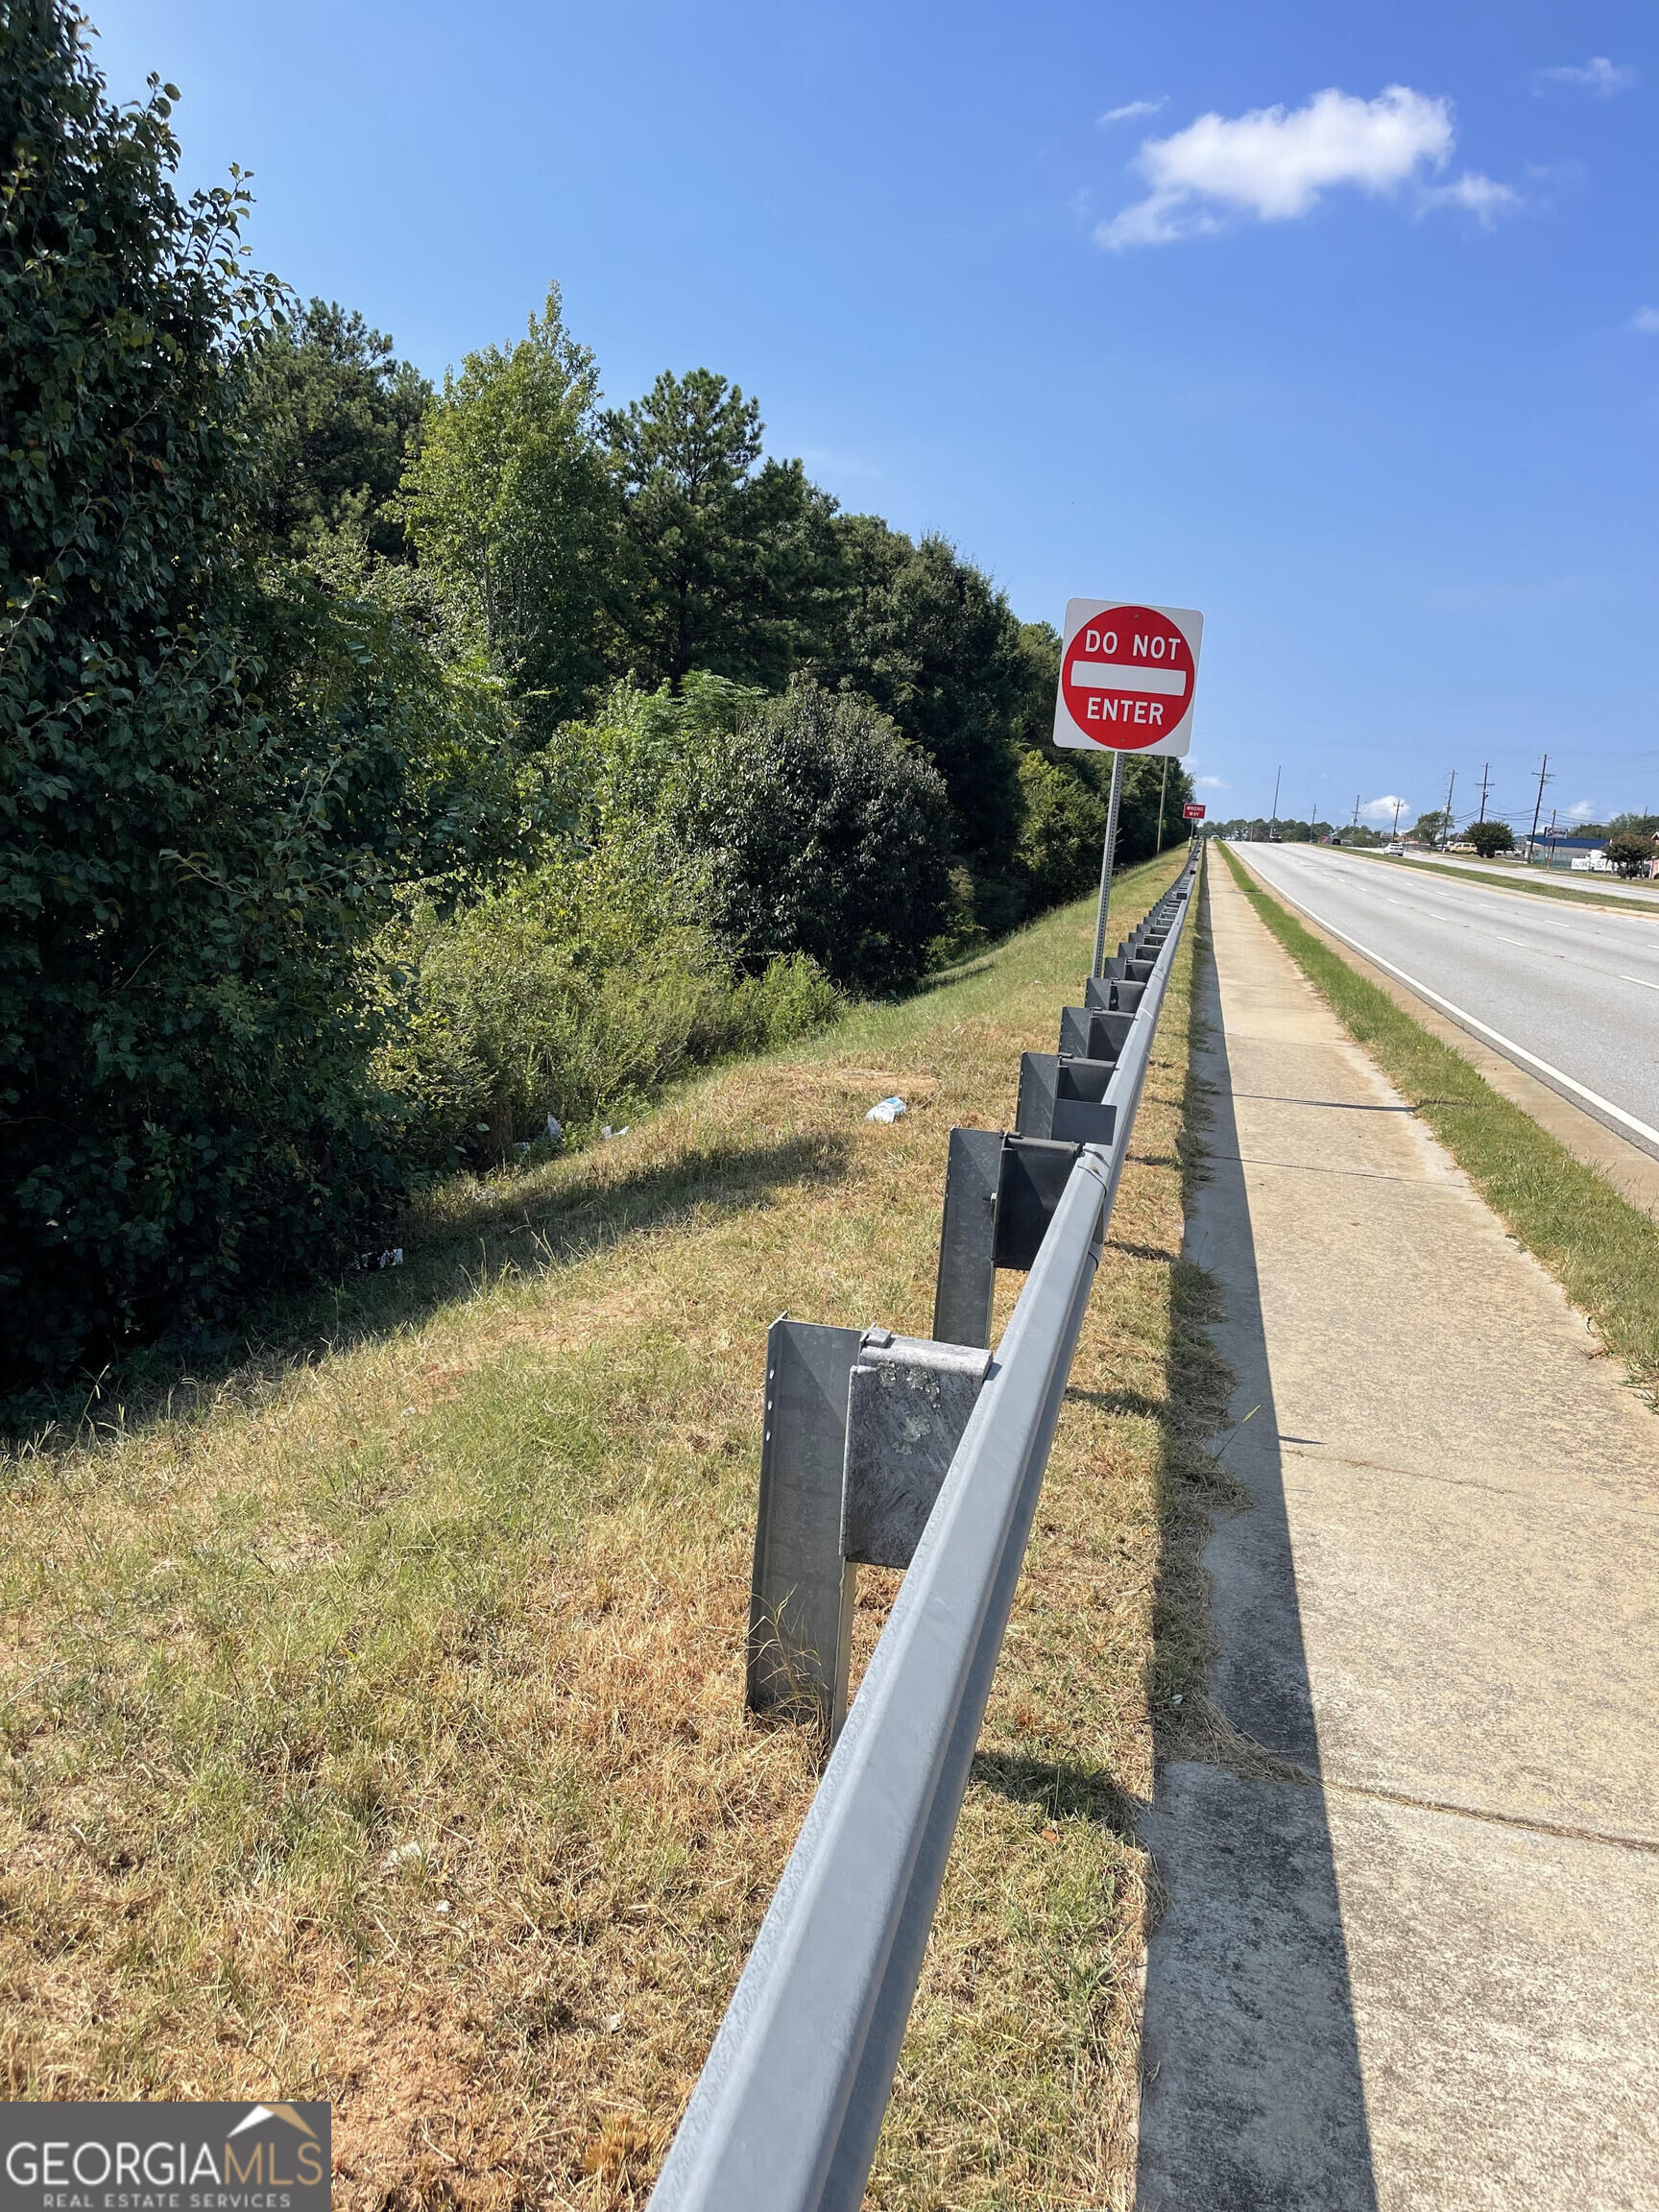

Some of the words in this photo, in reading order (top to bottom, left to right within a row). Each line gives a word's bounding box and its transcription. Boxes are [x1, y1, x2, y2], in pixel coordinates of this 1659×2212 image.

[1085, 629, 1118, 655] DO
[1132, 634, 1181, 661] NOT
[1086, 696, 1165, 726] ENTER
